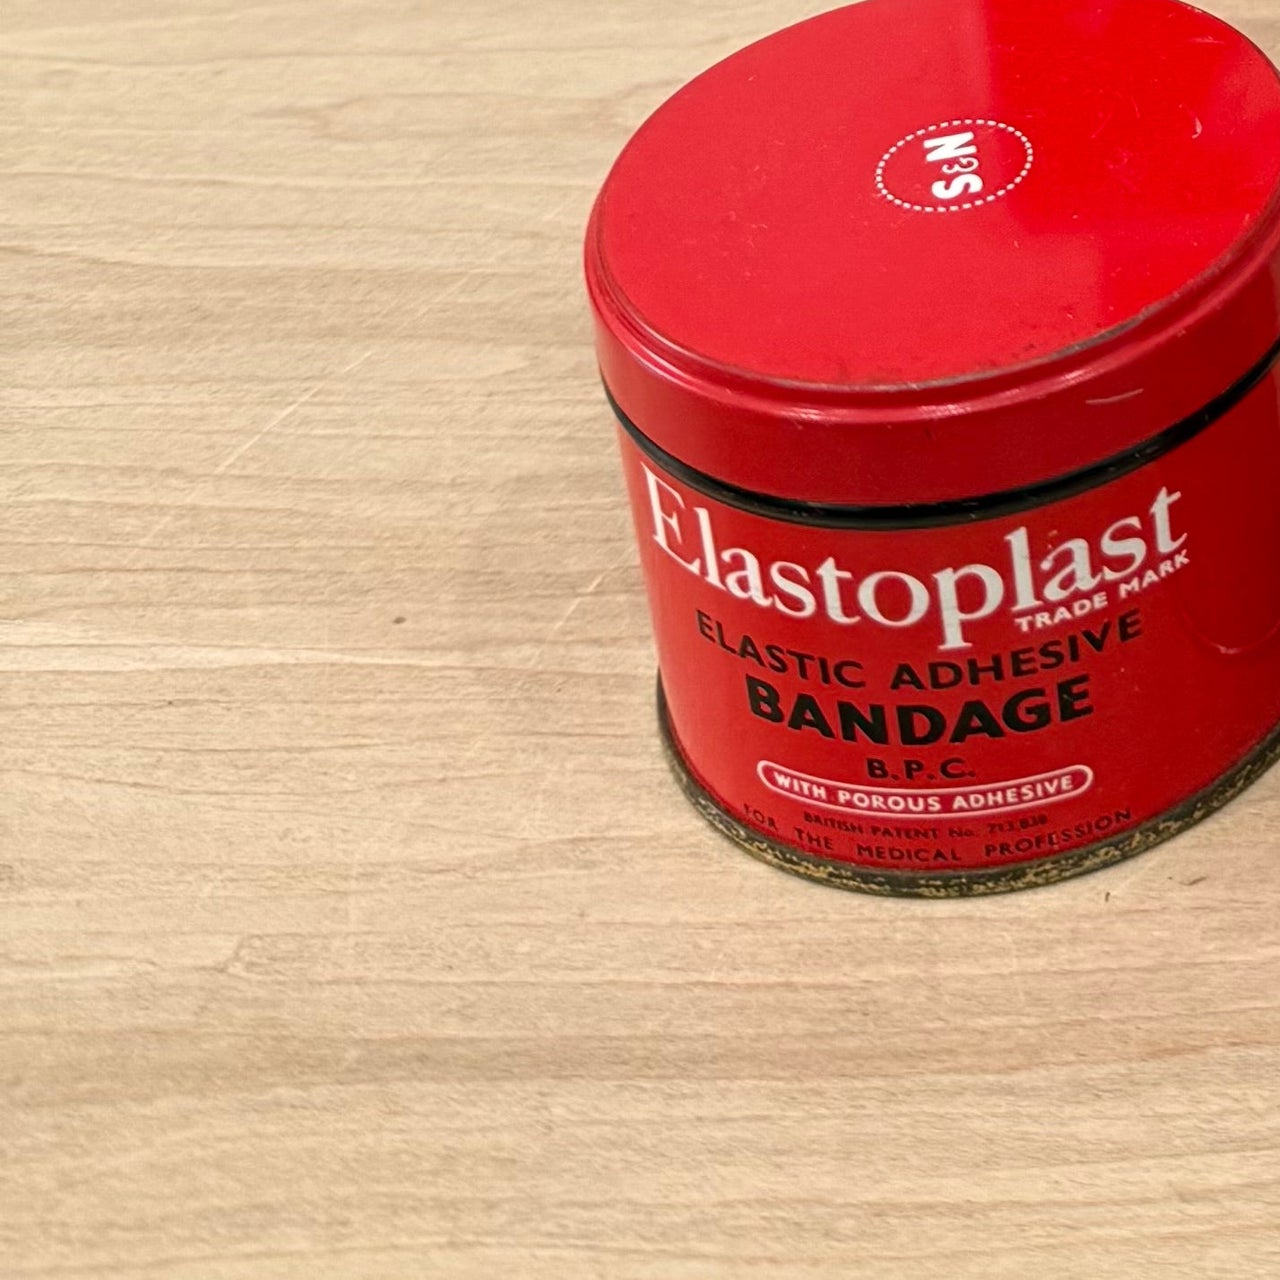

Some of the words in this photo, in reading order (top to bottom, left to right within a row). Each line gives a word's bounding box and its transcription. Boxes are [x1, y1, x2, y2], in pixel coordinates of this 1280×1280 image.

[640, 461, 1188, 651] Elastoplast
[1014, 591, 1109, 633] TRADE
[1118, 548, 1191, 600] MARK
[696, 608, 866, 689] ELASTIC
[890, 607, 1144, 691] ADHESIVE
[745, 673, 1095, 746] BANDAGE
[773, 770, 827, 801] WITH
[837, 788, 942, 813] POROUS
[951, 773, 1075, 811] ADHESIVE
[865, 757, 977, 781] B.P.C.
[743, 802, 778, 831] FOR
[793, 826, 834, 851] THE
[856, 843, 963, 864] MEDICAL
[983, 808, 1134, 859] PROFESSION
